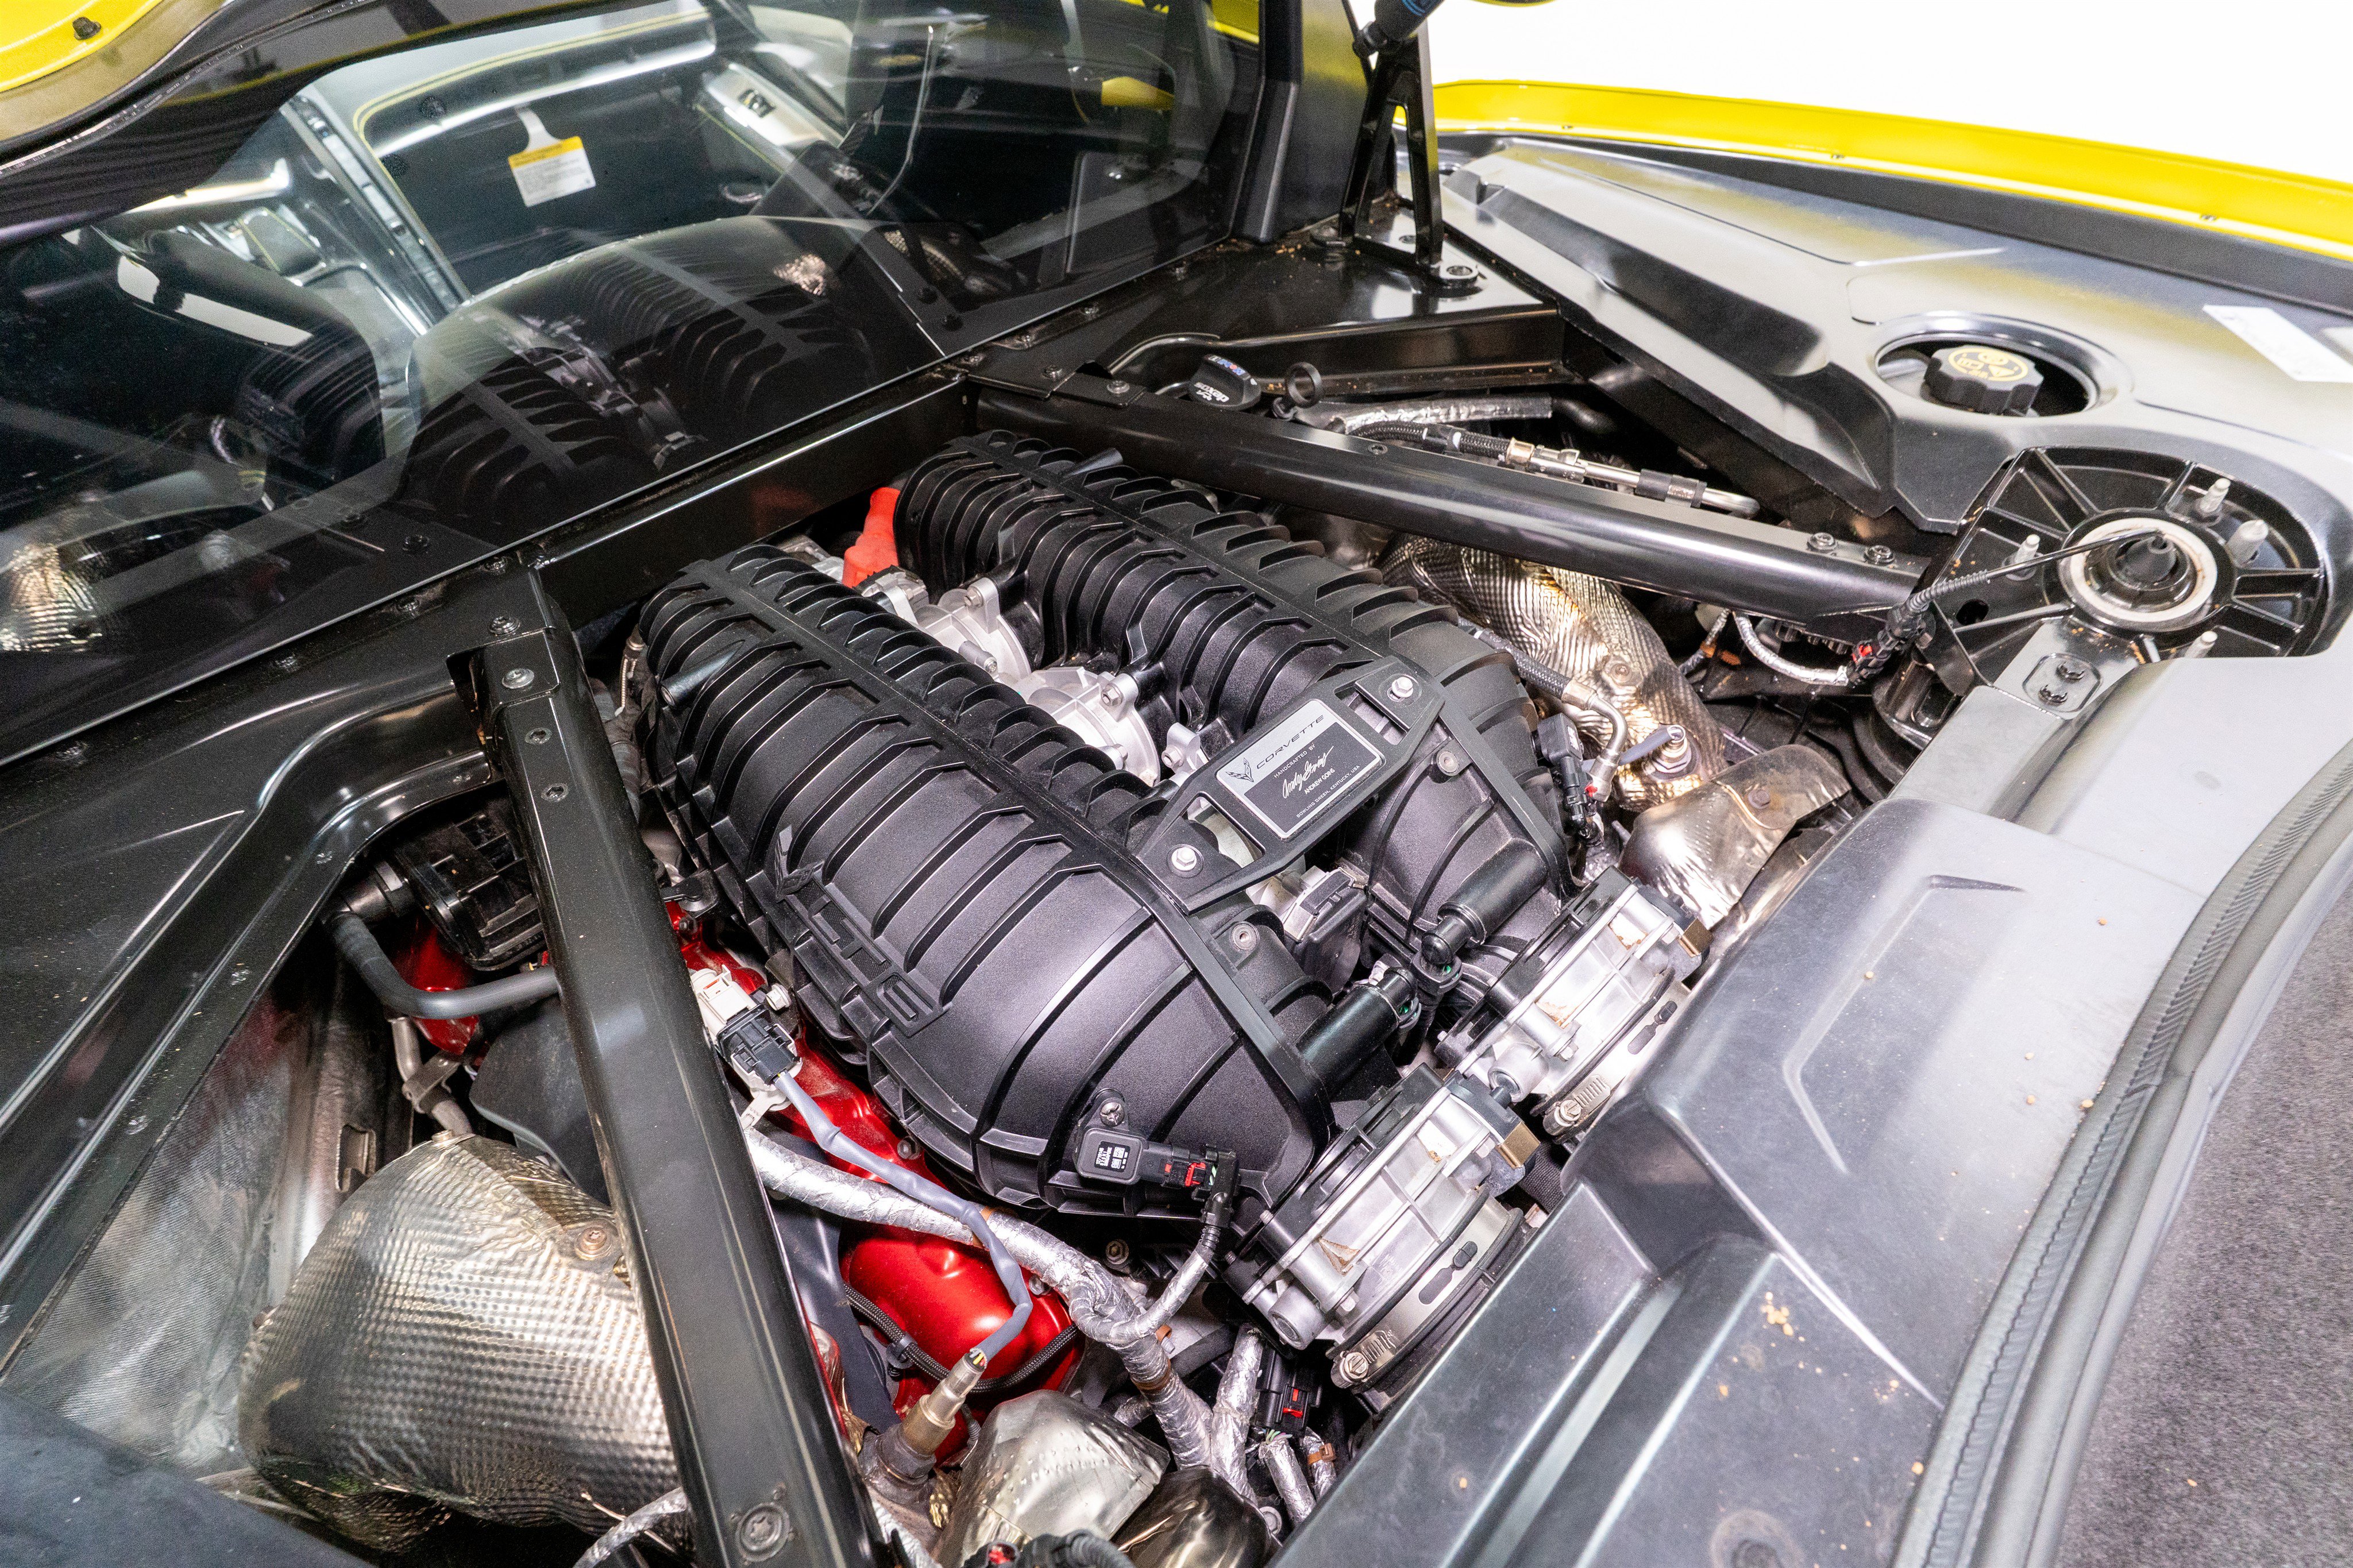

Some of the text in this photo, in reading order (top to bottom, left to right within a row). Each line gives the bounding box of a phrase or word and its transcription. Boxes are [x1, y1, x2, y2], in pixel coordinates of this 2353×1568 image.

[1194, 382, 1229, 402] dexos
[1256, 715, 1324, 770] CORVETTE
[1273, 750, 1307, 778] HANDCRAFTED
[1296, 765, 1360, 818] BOWLING GREEN, KENTUCKY, USA
[1304, 767, 1336, 795] ANDREW GOINS
